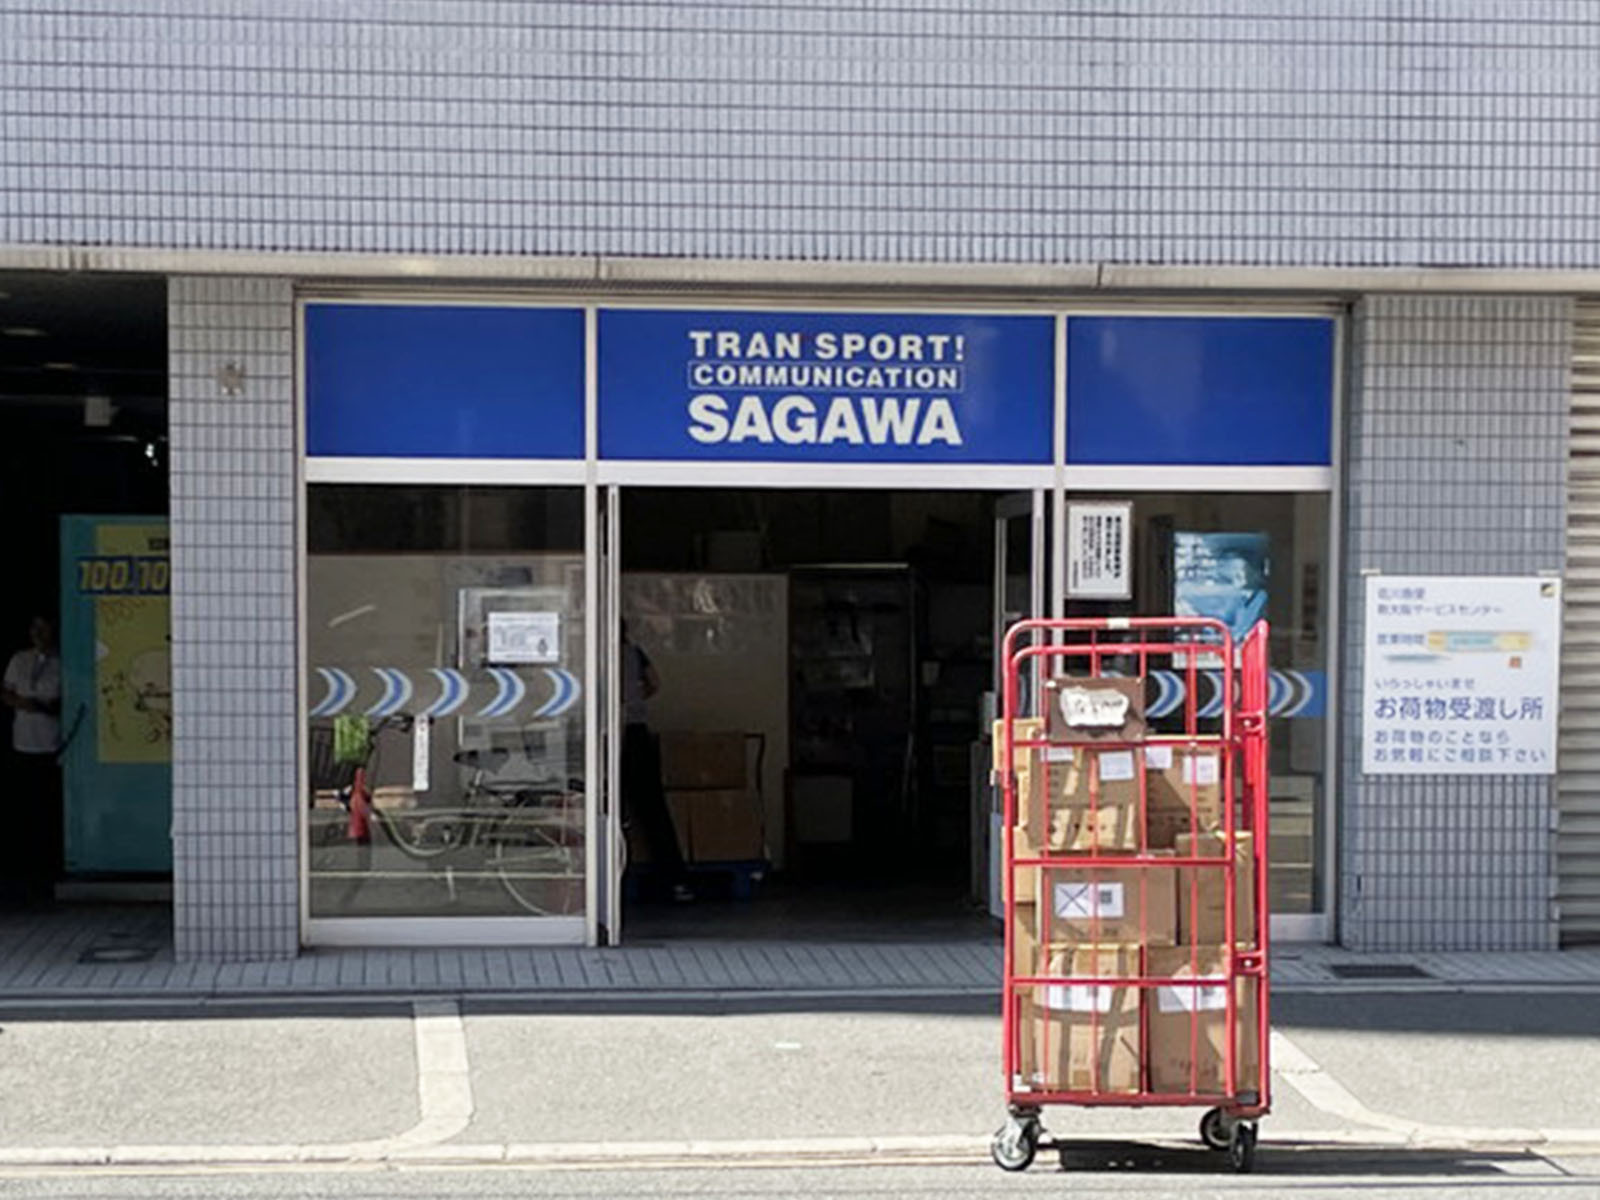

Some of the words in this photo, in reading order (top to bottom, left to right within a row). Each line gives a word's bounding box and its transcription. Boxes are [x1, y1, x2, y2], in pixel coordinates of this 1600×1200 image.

[688, 331, 801, 358] TRAN
[815, 333, 965, 361] SPORT!
[694, 365, 958, 389] COMMUNICATION
[687, 394, 964, 446] SAGAWA
[1374, 696, 1544, 721] お荷物受渡し所
